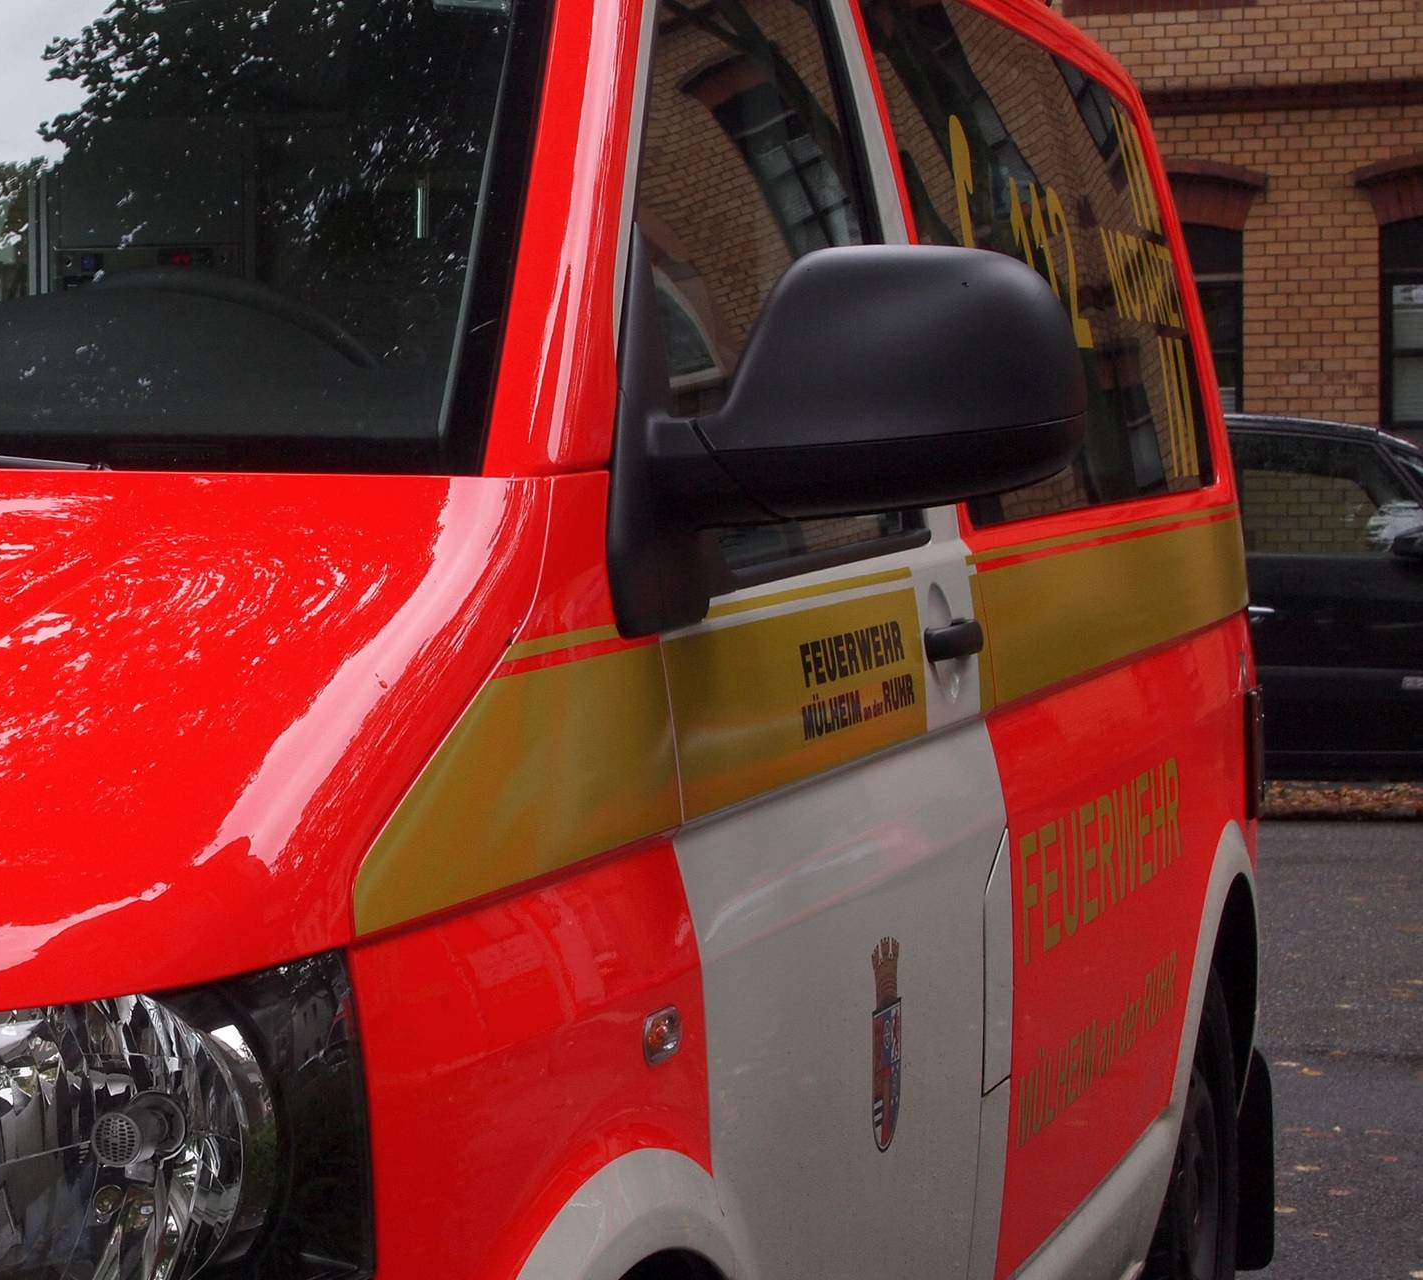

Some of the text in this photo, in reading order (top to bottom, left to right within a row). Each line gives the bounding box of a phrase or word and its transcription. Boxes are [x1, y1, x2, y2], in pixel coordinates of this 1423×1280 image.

[1009, 176, 1093, 347] 112
[1100, 226, 1186, 330] NOTARZT
[799, 620, 905, 688] FEUERWEHR
[801, 673, 915, 741] MÜLHEIM an der RUHR
[1019, 757, 1183, 966] FEUERWEHR
[1017, 951, 1178, 1148] MÜLHEIM an der RUHR
